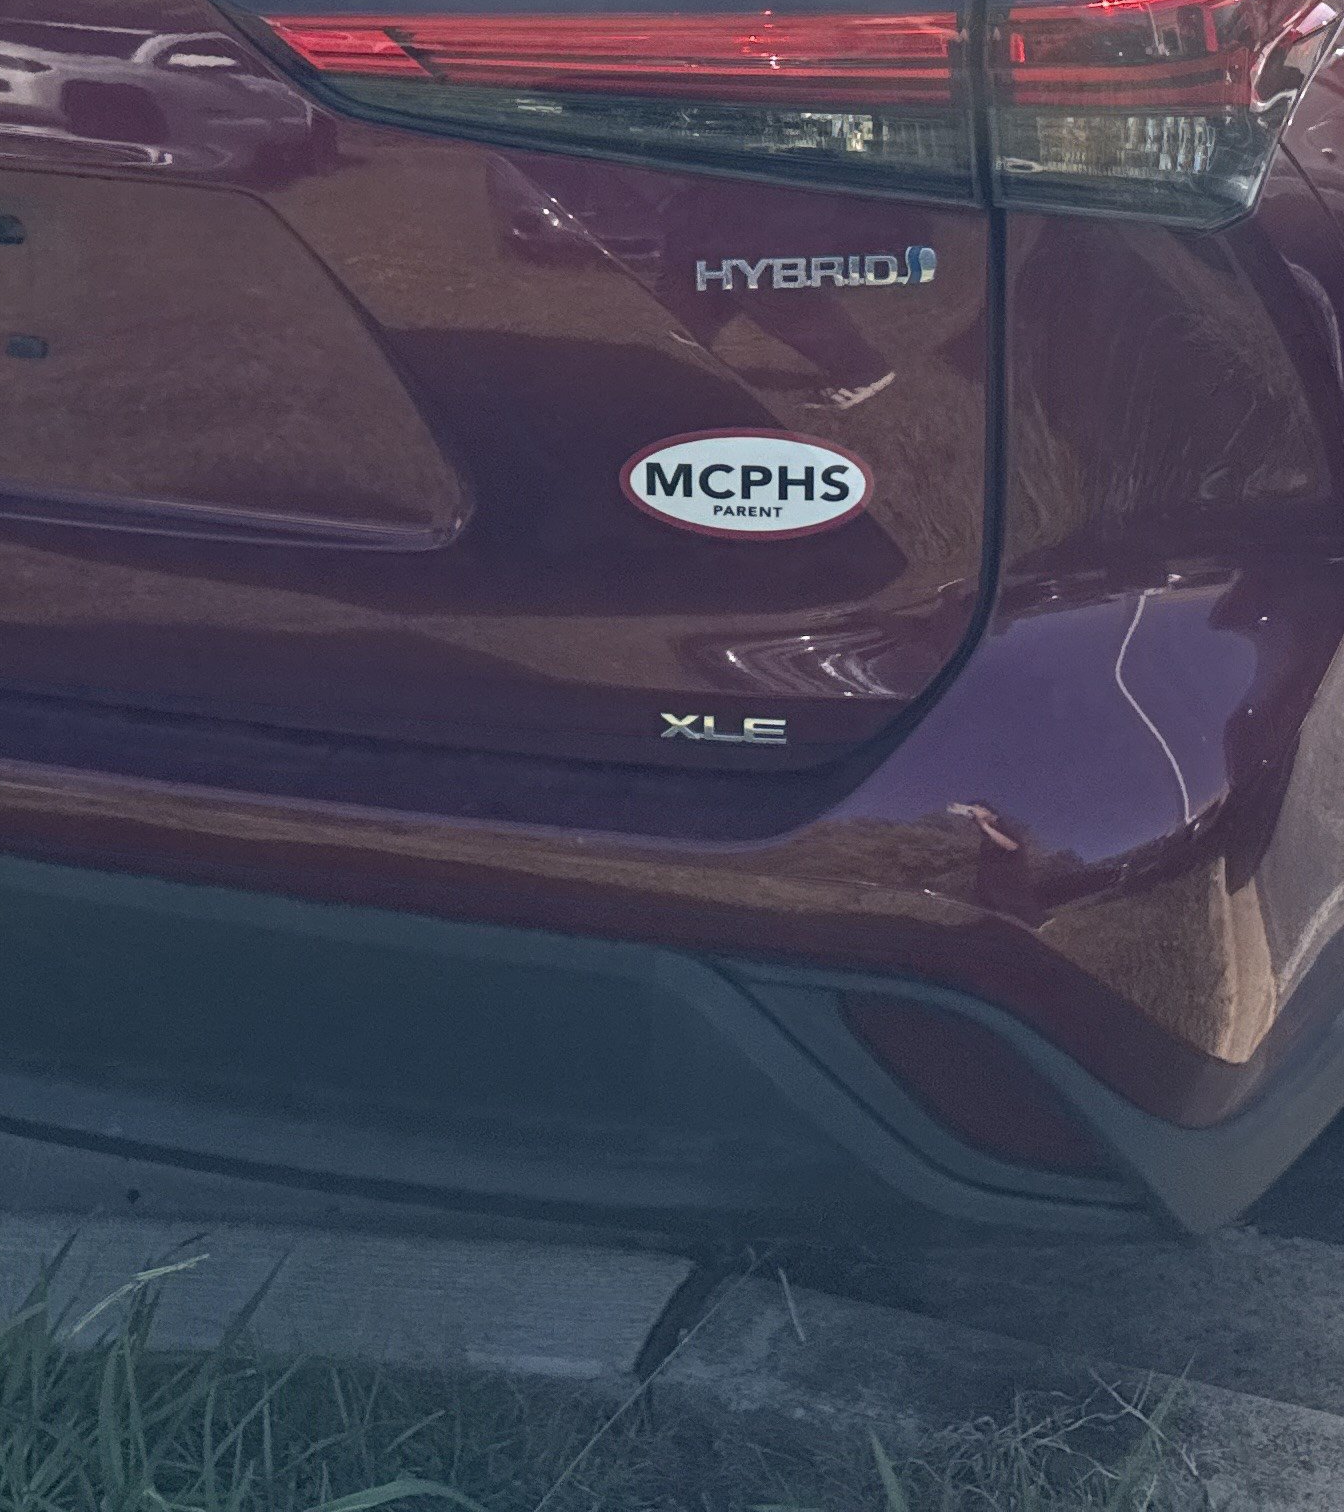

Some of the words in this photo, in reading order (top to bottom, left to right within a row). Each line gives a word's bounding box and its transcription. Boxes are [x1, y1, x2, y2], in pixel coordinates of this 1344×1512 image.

[697, 255, 898, 291] HYBRID
[645, 462, 850, 502] MCPHS
[713, 505, 783, 518] PARENT
[661, 713, 787, 745] XLE
